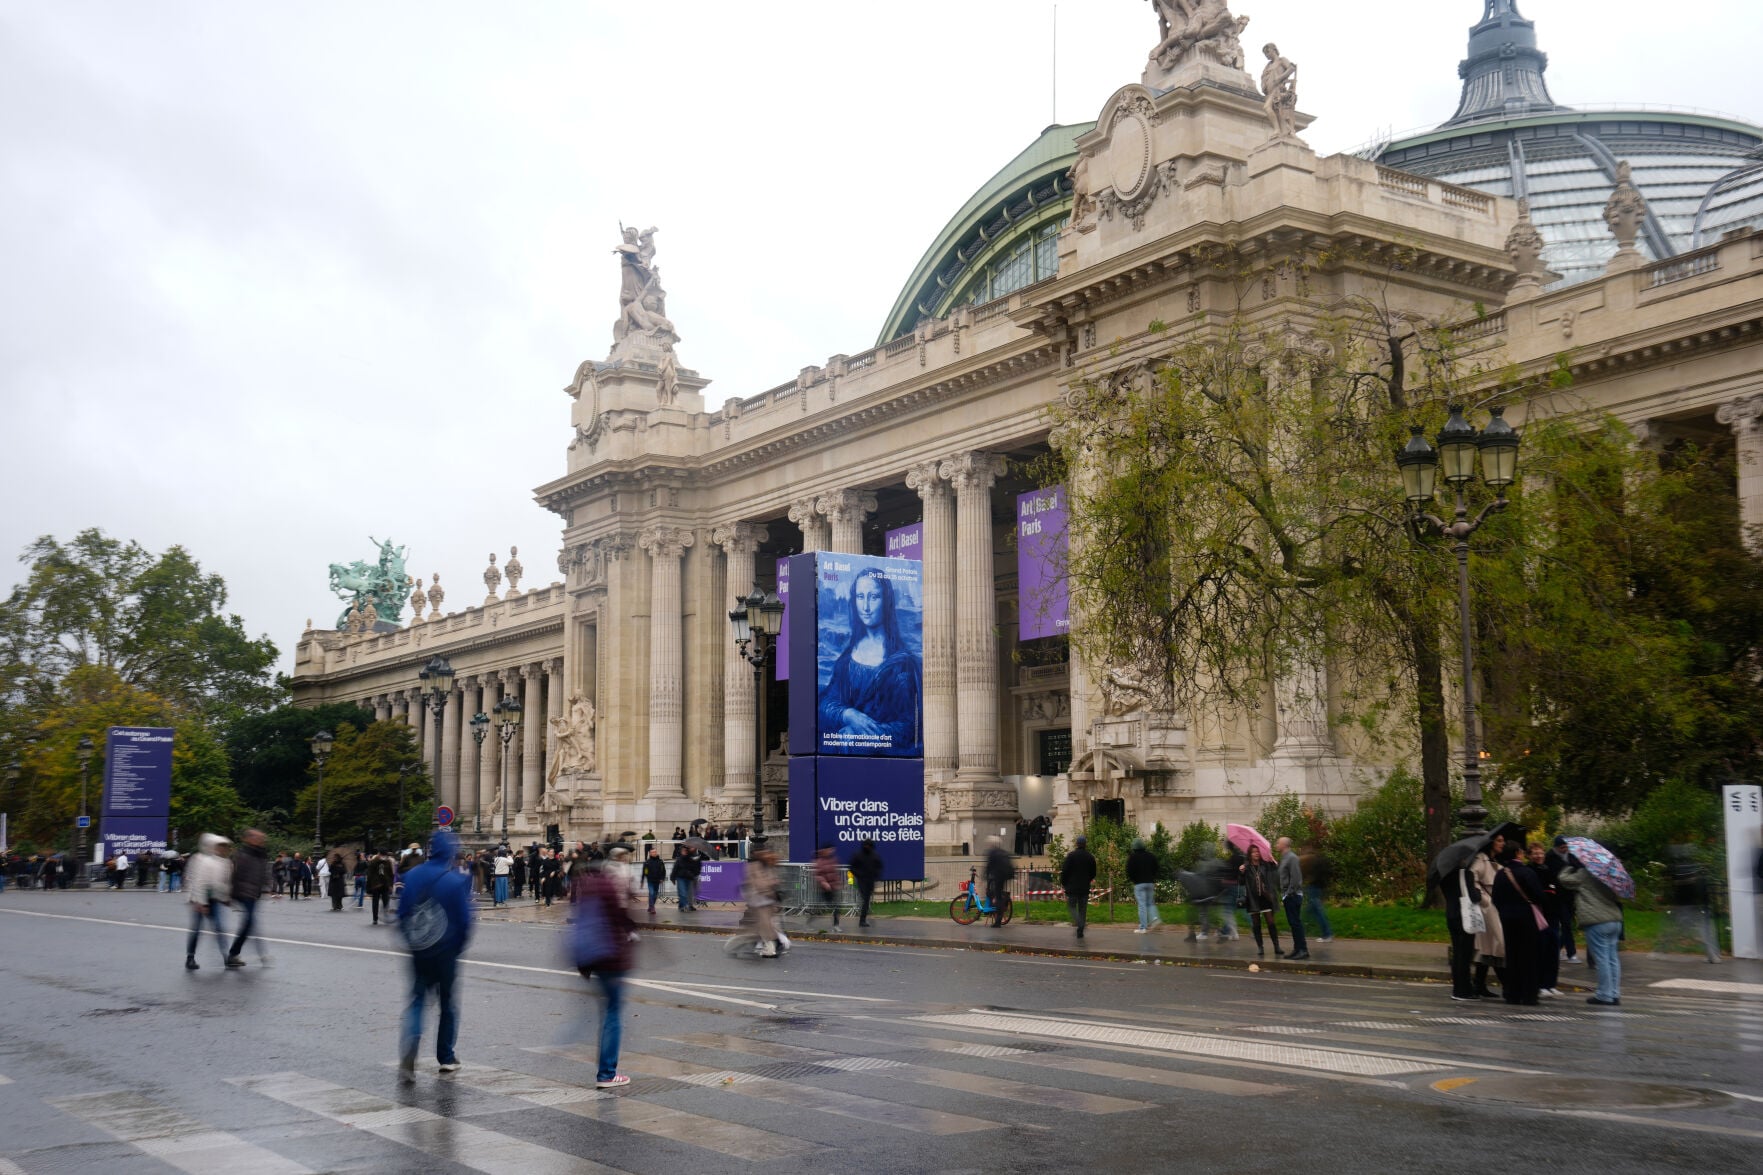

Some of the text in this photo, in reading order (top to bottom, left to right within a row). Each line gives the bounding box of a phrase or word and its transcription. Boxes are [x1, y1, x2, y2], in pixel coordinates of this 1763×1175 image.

[1021, 493, 1057, 516] Art Basel
[1021, 519, 1041, 536] Paris
[889, 530, 919, 551] Art Basel
[779, 563, 788, 578] Art
[823, 560, 851, 572] Art Basel
[823, 572, 839, 581] Paris
[779, 580, 789, 594] Par
[820, 797, 888, 812] Vibrer dans
[1730, 792, 1742, 812] VIP
[834, 812, 923, 826] un Grand Palais
[839, 828, 923, 841] où tout se fête.
[707, 865, 722, 873] Basel
